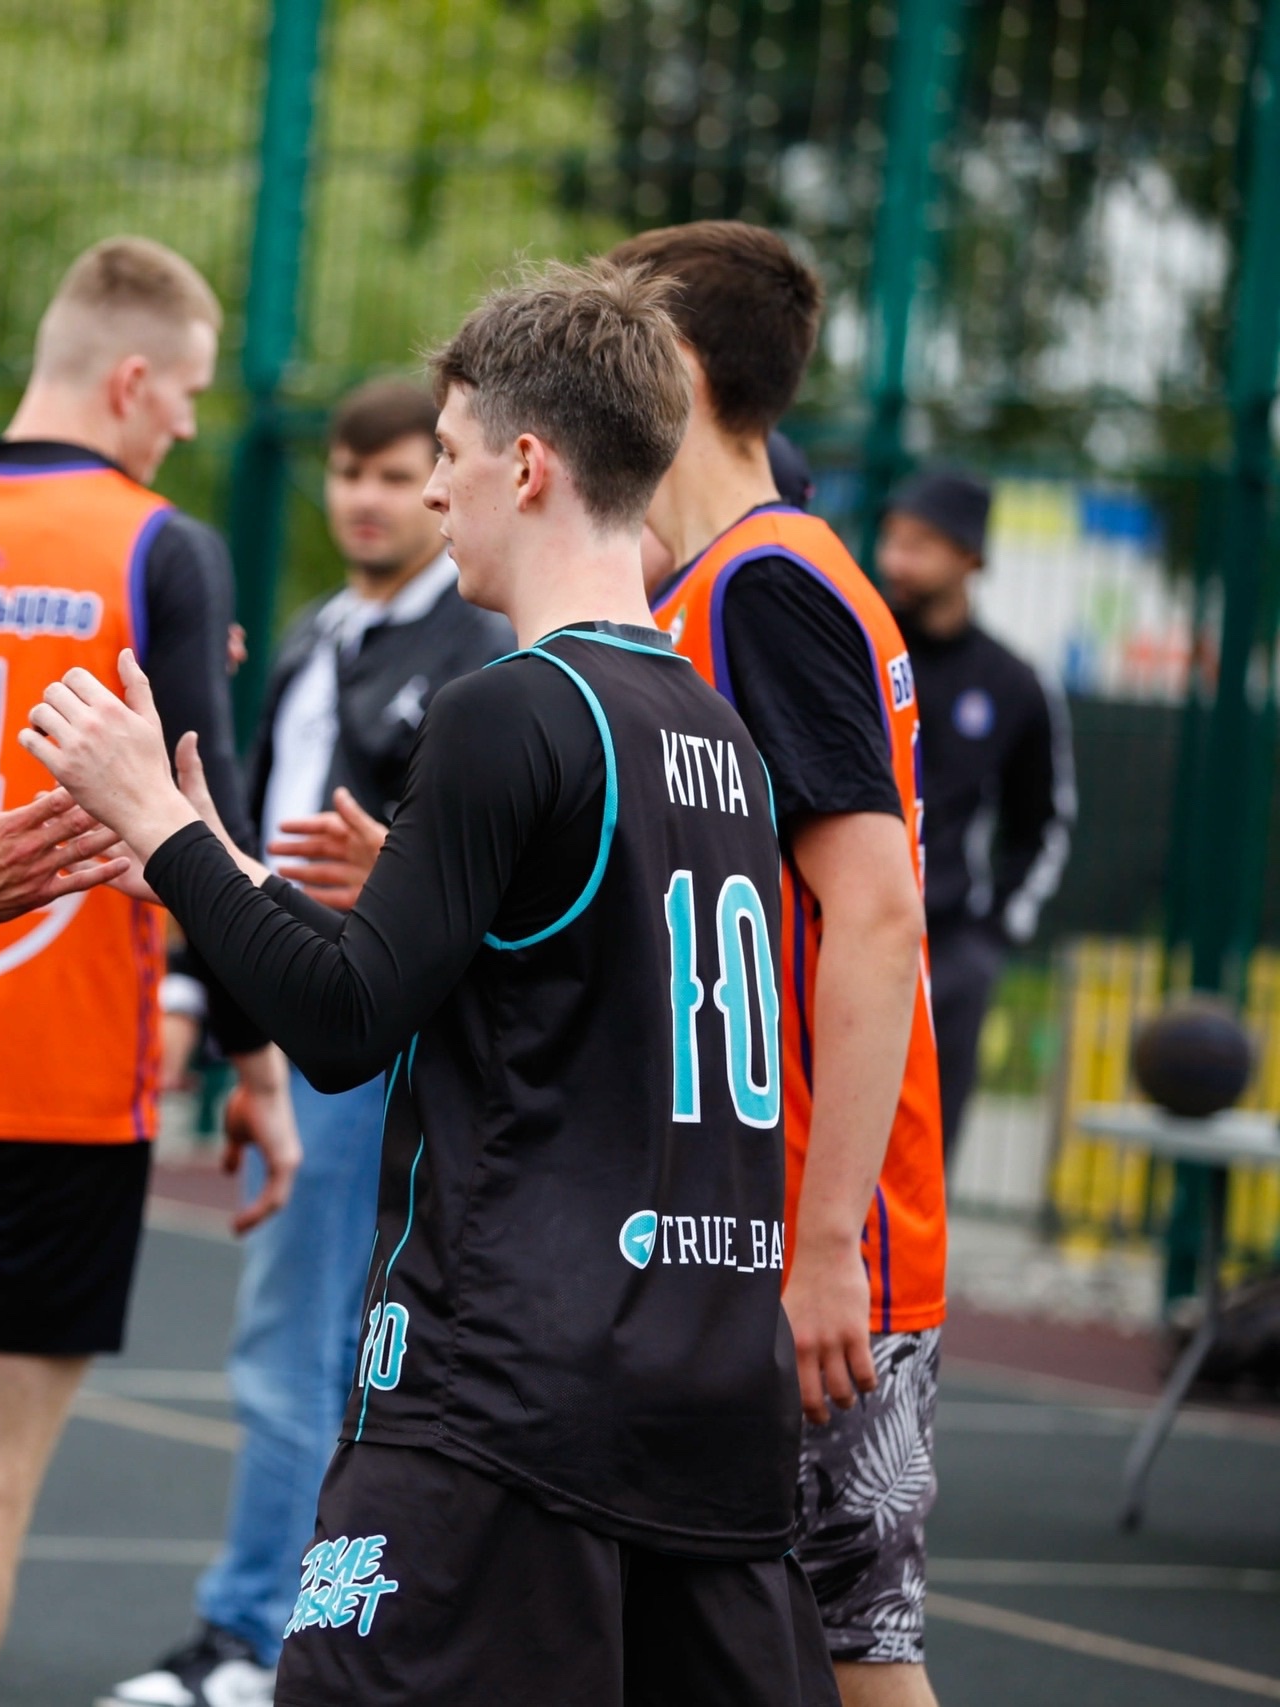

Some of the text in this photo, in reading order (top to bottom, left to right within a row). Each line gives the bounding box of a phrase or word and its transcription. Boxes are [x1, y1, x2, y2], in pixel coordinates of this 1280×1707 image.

[660, 728, 749, 817] KITYA
[664, 869, 780, 1129] 10
[661, 1215, 785, 1273] TRUE_BA
[358, 1302, 410, 1391] 10
